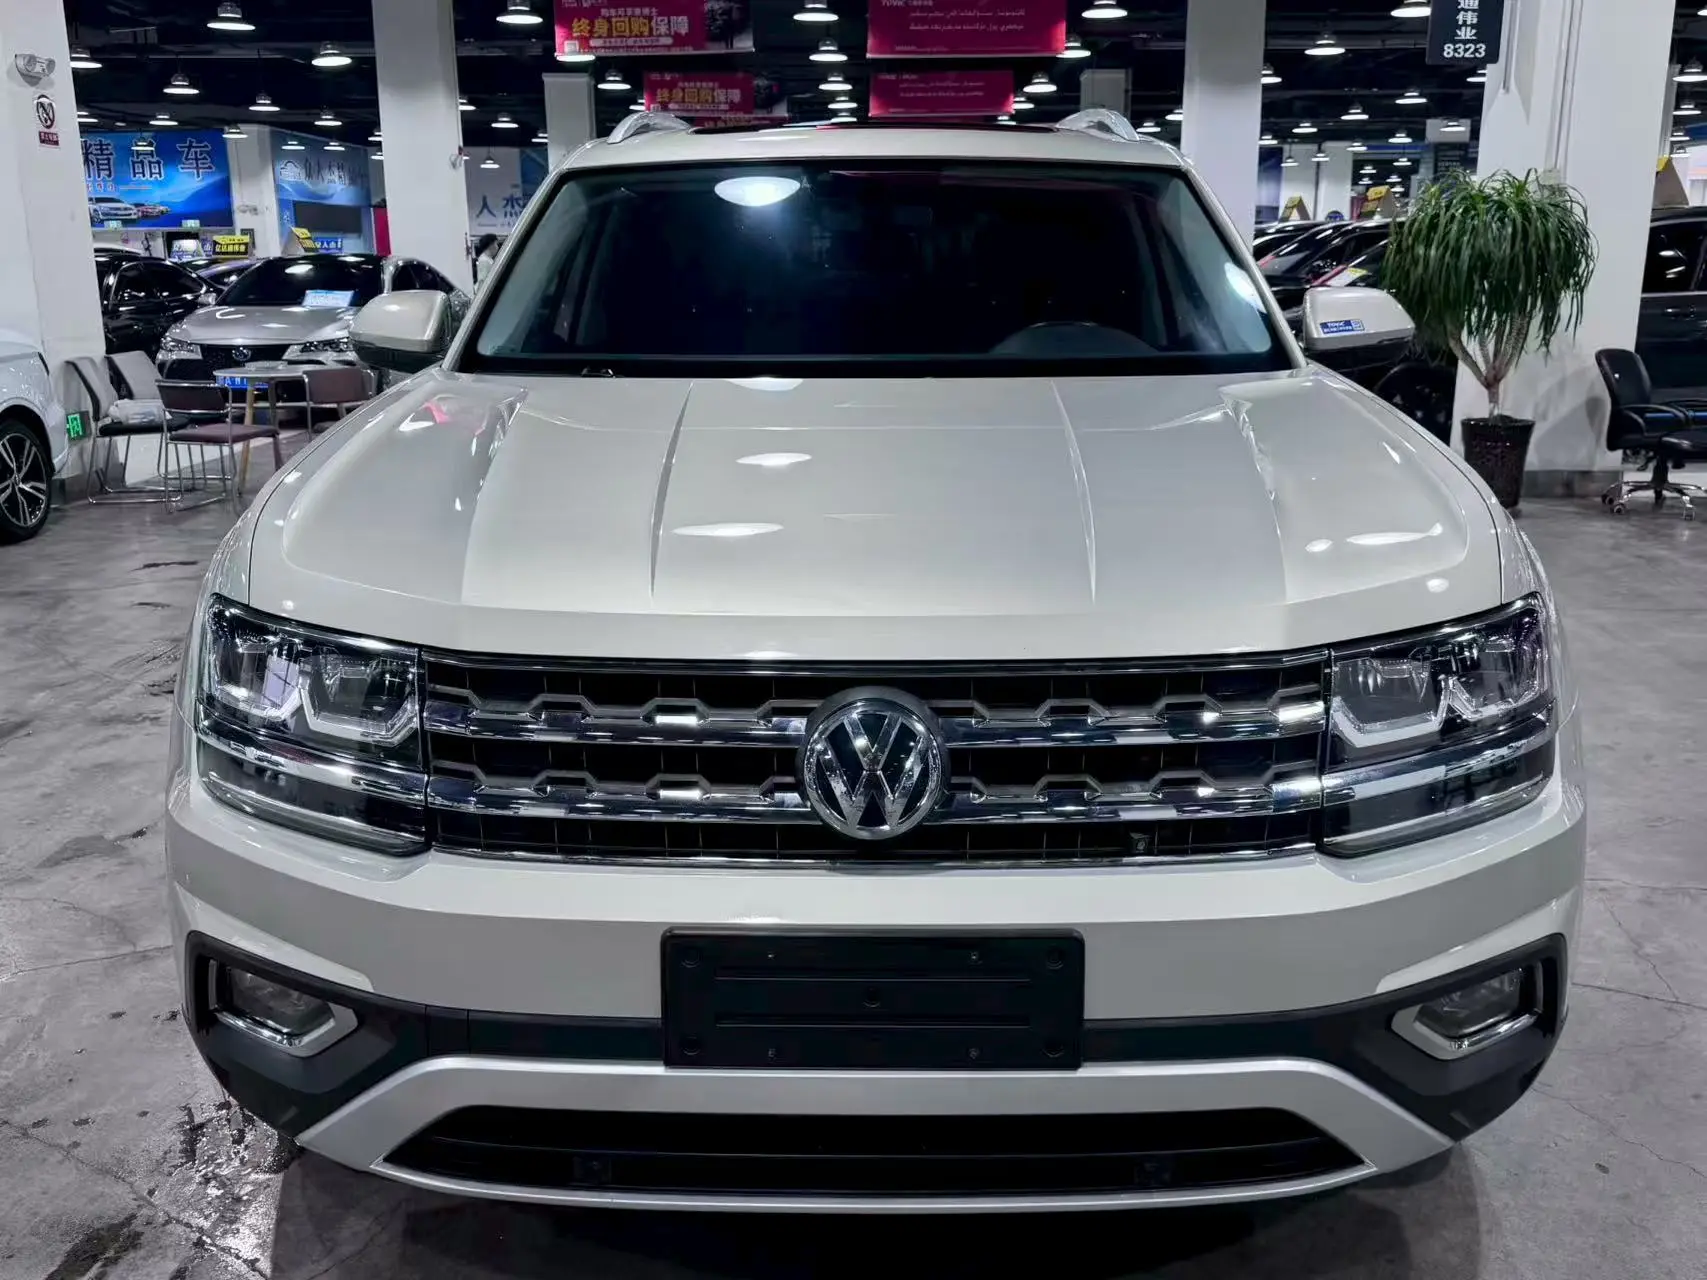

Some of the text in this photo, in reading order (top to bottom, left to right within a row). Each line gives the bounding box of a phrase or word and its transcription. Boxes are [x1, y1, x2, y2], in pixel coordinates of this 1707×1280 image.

[572, 16, 689, 37] 终身回购保障
[1443, 43, 1486, 58] 8323
[82, 138, 215, 180] 精品车
